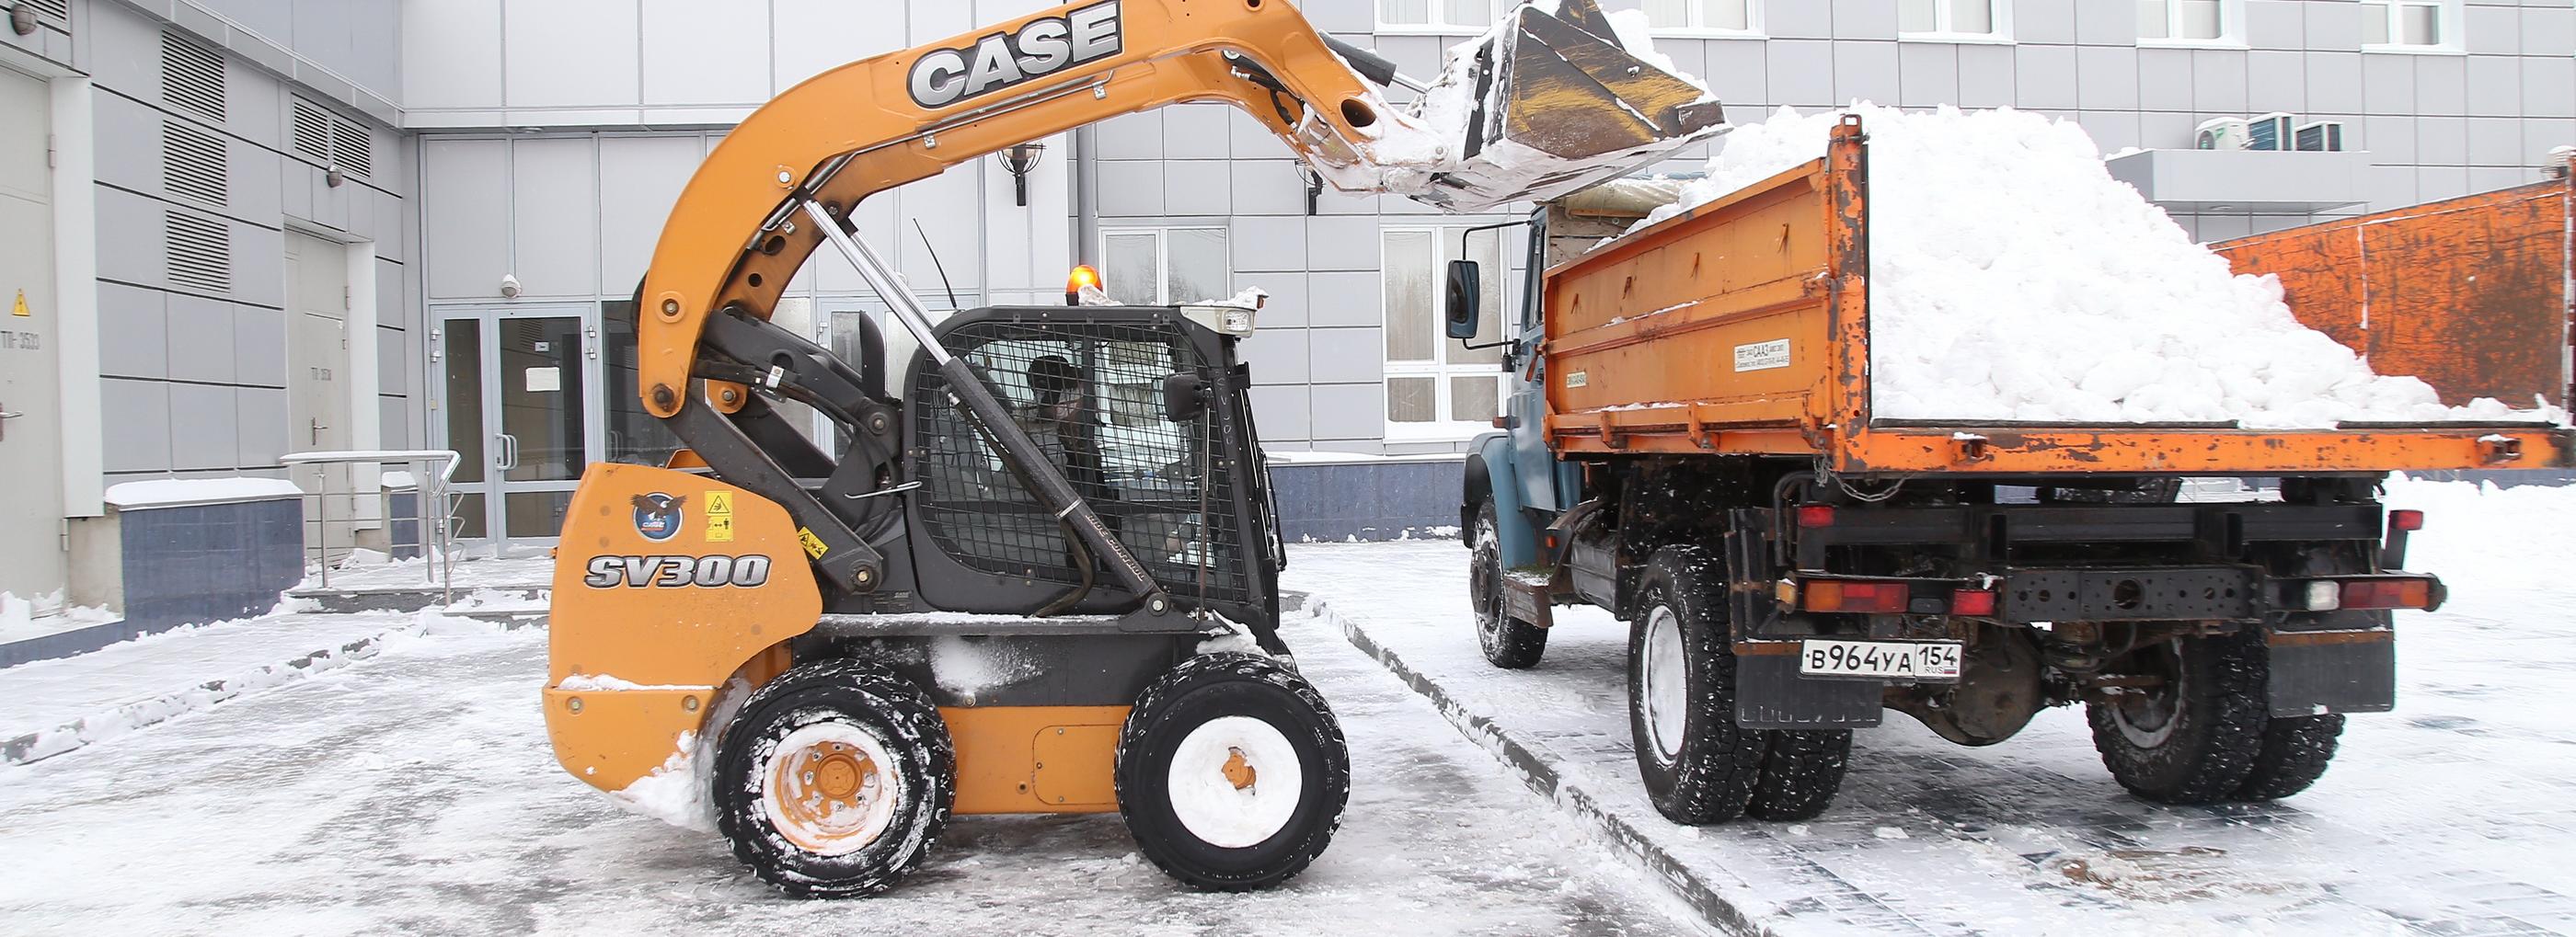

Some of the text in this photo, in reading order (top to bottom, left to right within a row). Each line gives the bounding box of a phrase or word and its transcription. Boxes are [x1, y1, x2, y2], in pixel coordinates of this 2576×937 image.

[910, 2, 1121, 107] CASE
[584, 554, 772, 588] SV300
[1918, 646, 1958, 667] 154
[1925, 666, 1944, 674] RUS
